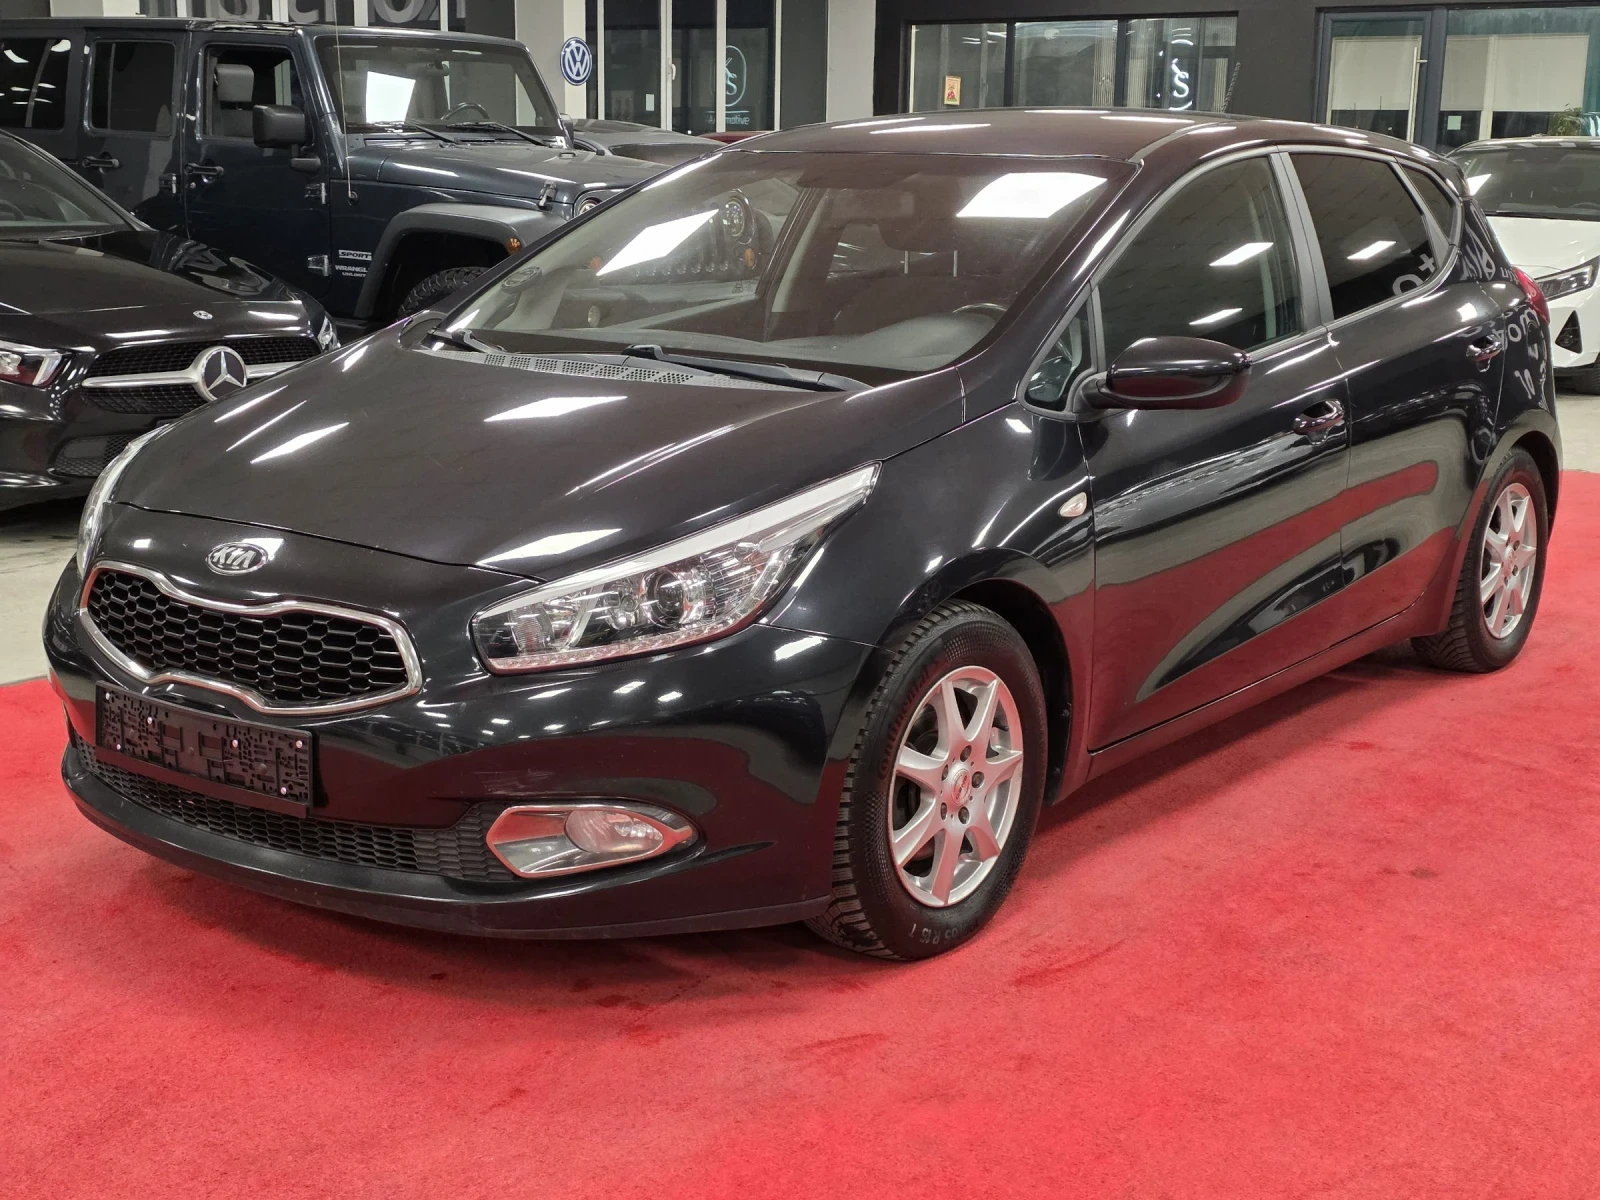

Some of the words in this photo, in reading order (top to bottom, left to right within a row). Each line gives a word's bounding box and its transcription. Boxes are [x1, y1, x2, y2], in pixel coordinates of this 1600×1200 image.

[563, 40, 591, 83] VW
[340, 251, 370, 259] SPORT
[335, 264, 368, 272] WRANGL
[212, 546, 257, 569] KIA
